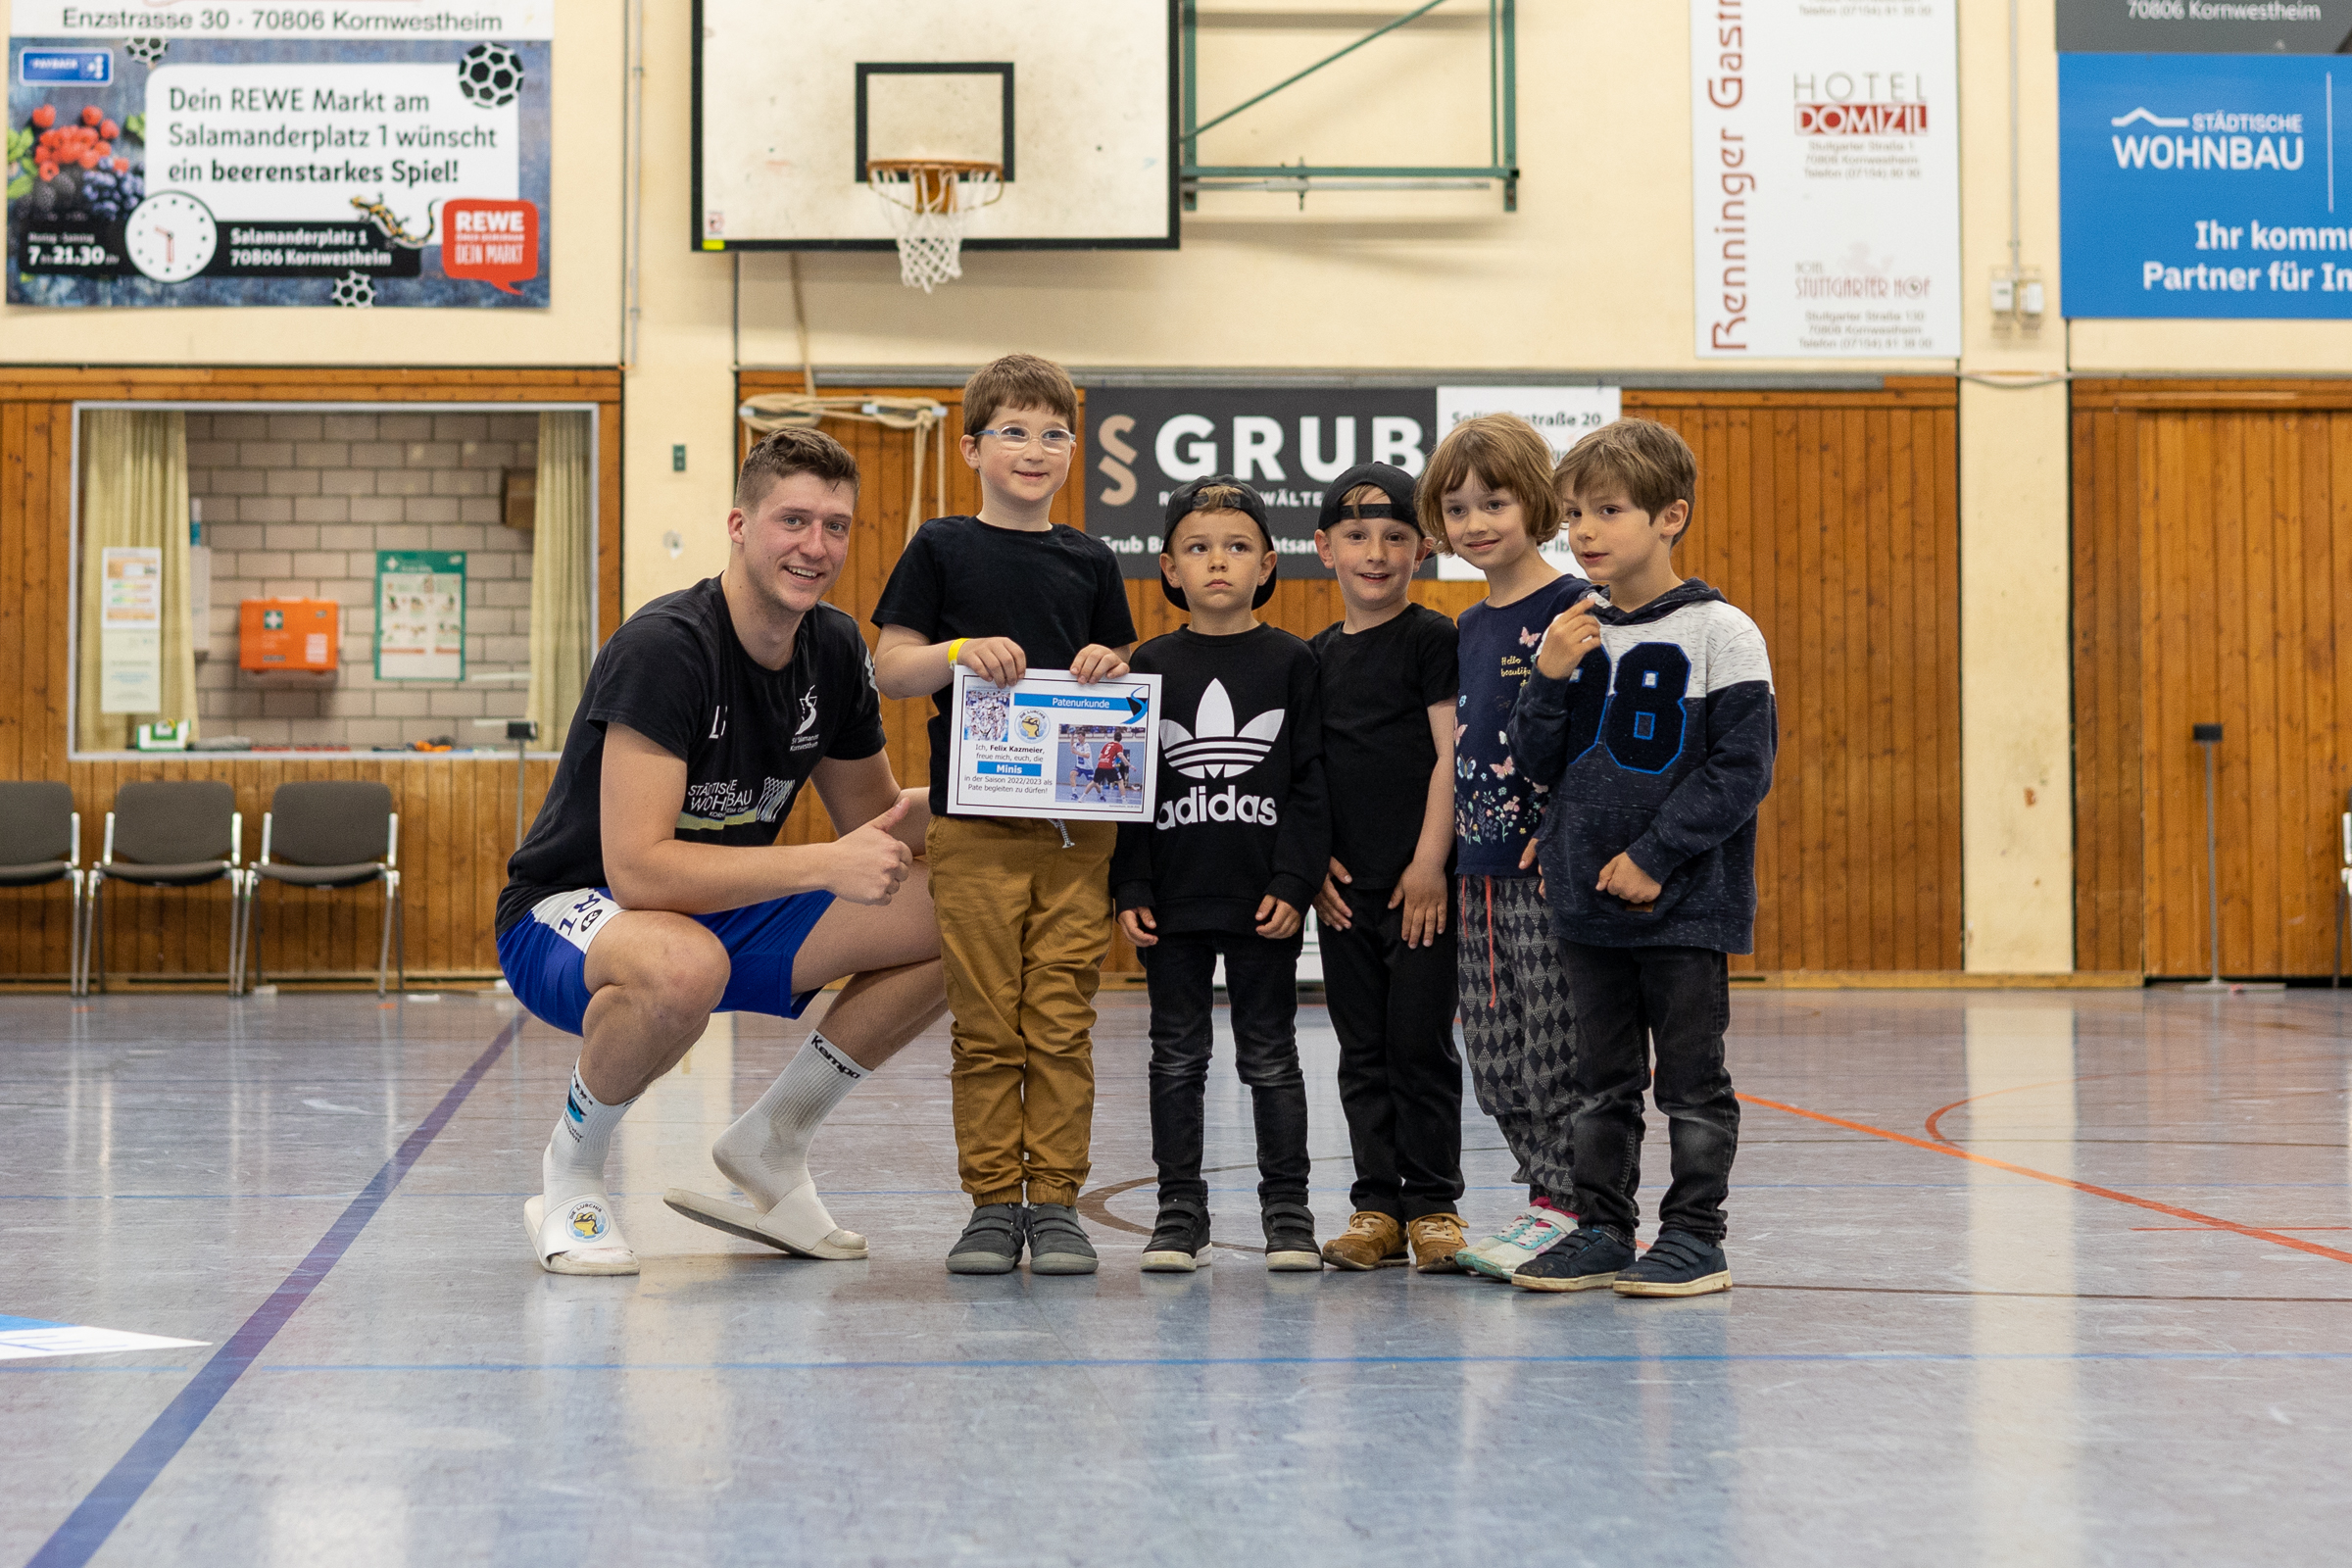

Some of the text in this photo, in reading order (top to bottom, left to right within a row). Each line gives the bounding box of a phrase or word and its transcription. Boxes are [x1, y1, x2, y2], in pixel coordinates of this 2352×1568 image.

[63, 8, 503, 31] Enzstrasse 30 70806 Kornwestheim
[2128, 0, 2322, 21] 70806 Kornwestheim
[1793, 72, 1927, 101] HOTEL
[170, 87, 429, 113] Dein REWE Markt am
[1796, 104, 1928, 133] DOMIZIL
[2192, 110, 2303, 133] STÄDTISCHE
[169, 123, 498, 153] Salamanderplatz 1 wünscht
[2112, 135, 2304, 170] WOHNBAU
[169, 160, 460, 188] ein beerenstarkes Spiel!
[455, 211, 524, 232] REWE
[230, 227, 368, 248] Salamanderplatz 1
[1711, 127, 1755, 351] Renninger
[2195, 220, 2352, 251] Ihr komm
[28, 245, 41, 266] 7
[230, 248, 392, 267] 70806 Kornwestheim
[1795, 275, 1932, 300] STUTTGARTER HOF
[2143, 261, 2261, 291] Partner
[2268, 260, 2314, 291] für
[1581, 413, 1601, 426] 20
[1154, 414, 1426, 483] GRUB
[1053, 697, 1110, 709] Patenurkunde
[996, 763, 1022, 774] Minis
[984, 784, 1013, 793] begleiten
[1156, 785, 1278, 831] adidas
[810, 1035, 861, 1079] Kempa
